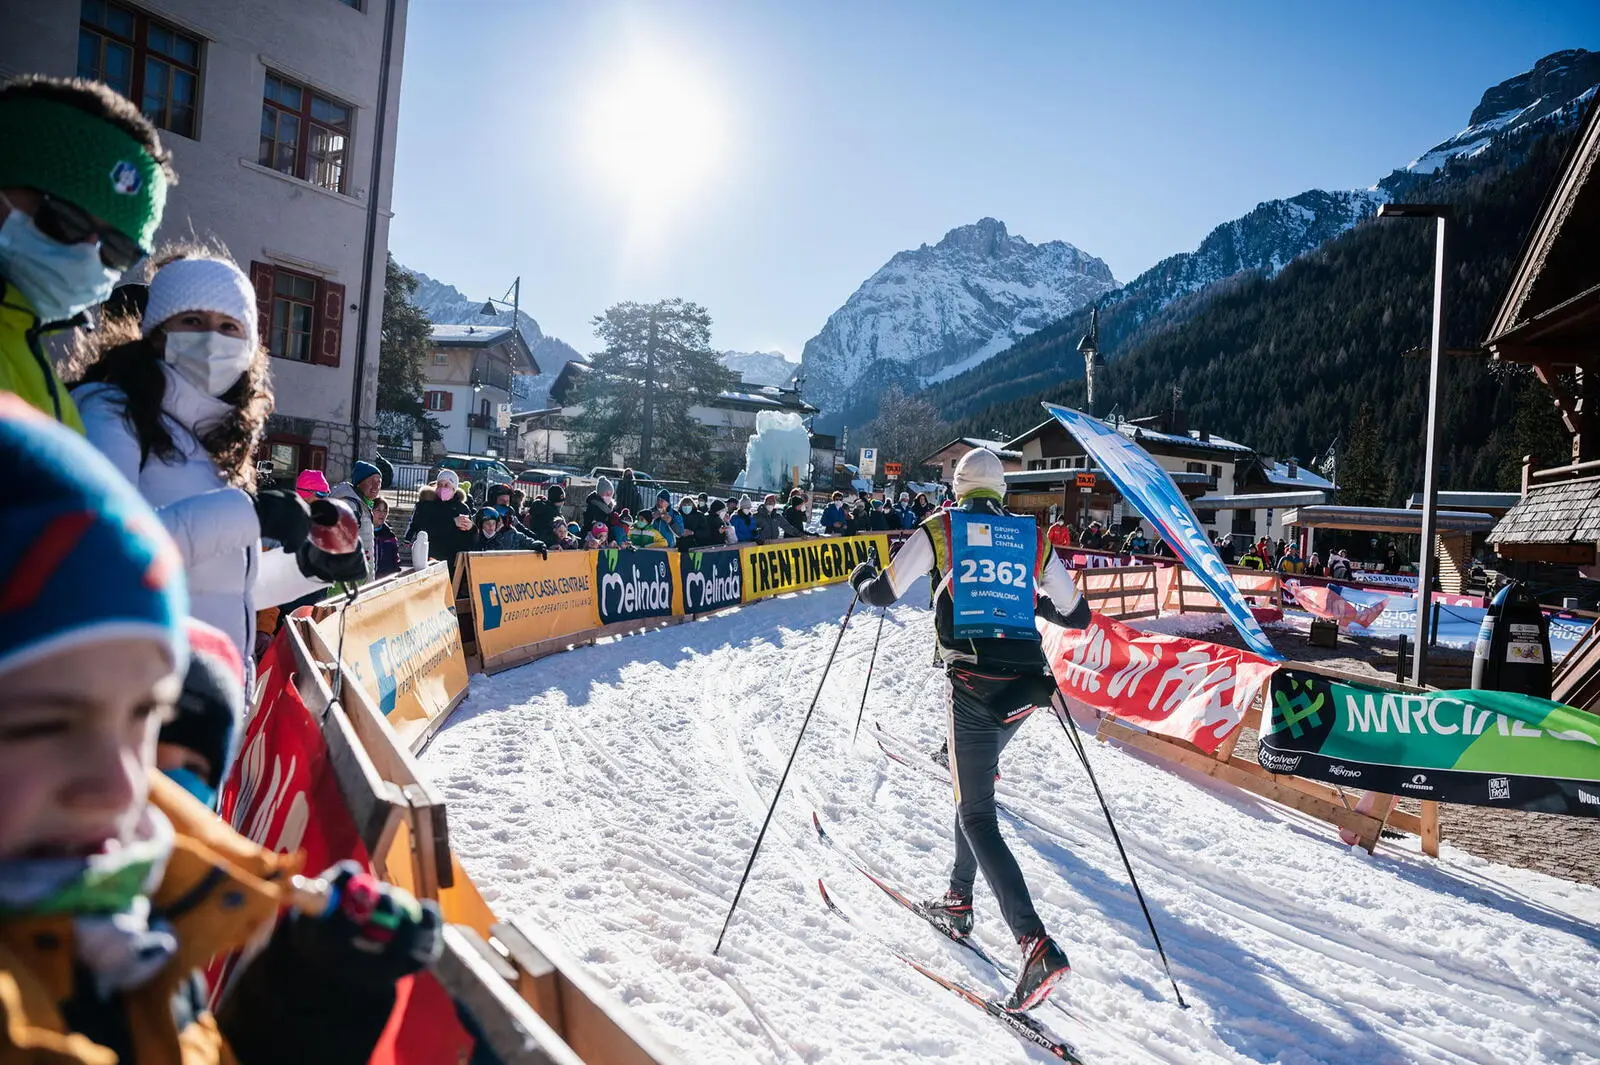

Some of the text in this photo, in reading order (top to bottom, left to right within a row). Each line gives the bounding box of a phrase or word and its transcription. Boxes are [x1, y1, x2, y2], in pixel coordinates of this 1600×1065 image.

[994, 526, 1020, 534] GRUPPO
[995, 540, 1024, 549] CENTRALE
[960, 559, 1027, 589] 2362
[500, 575, 590, 604] GRUPPO CASSA CENTRALE
[503, 607, 530, 622] CREDITO
[1260, 747, 1299, 764] Involved
[1578, 788, 1600, 805] WORL
